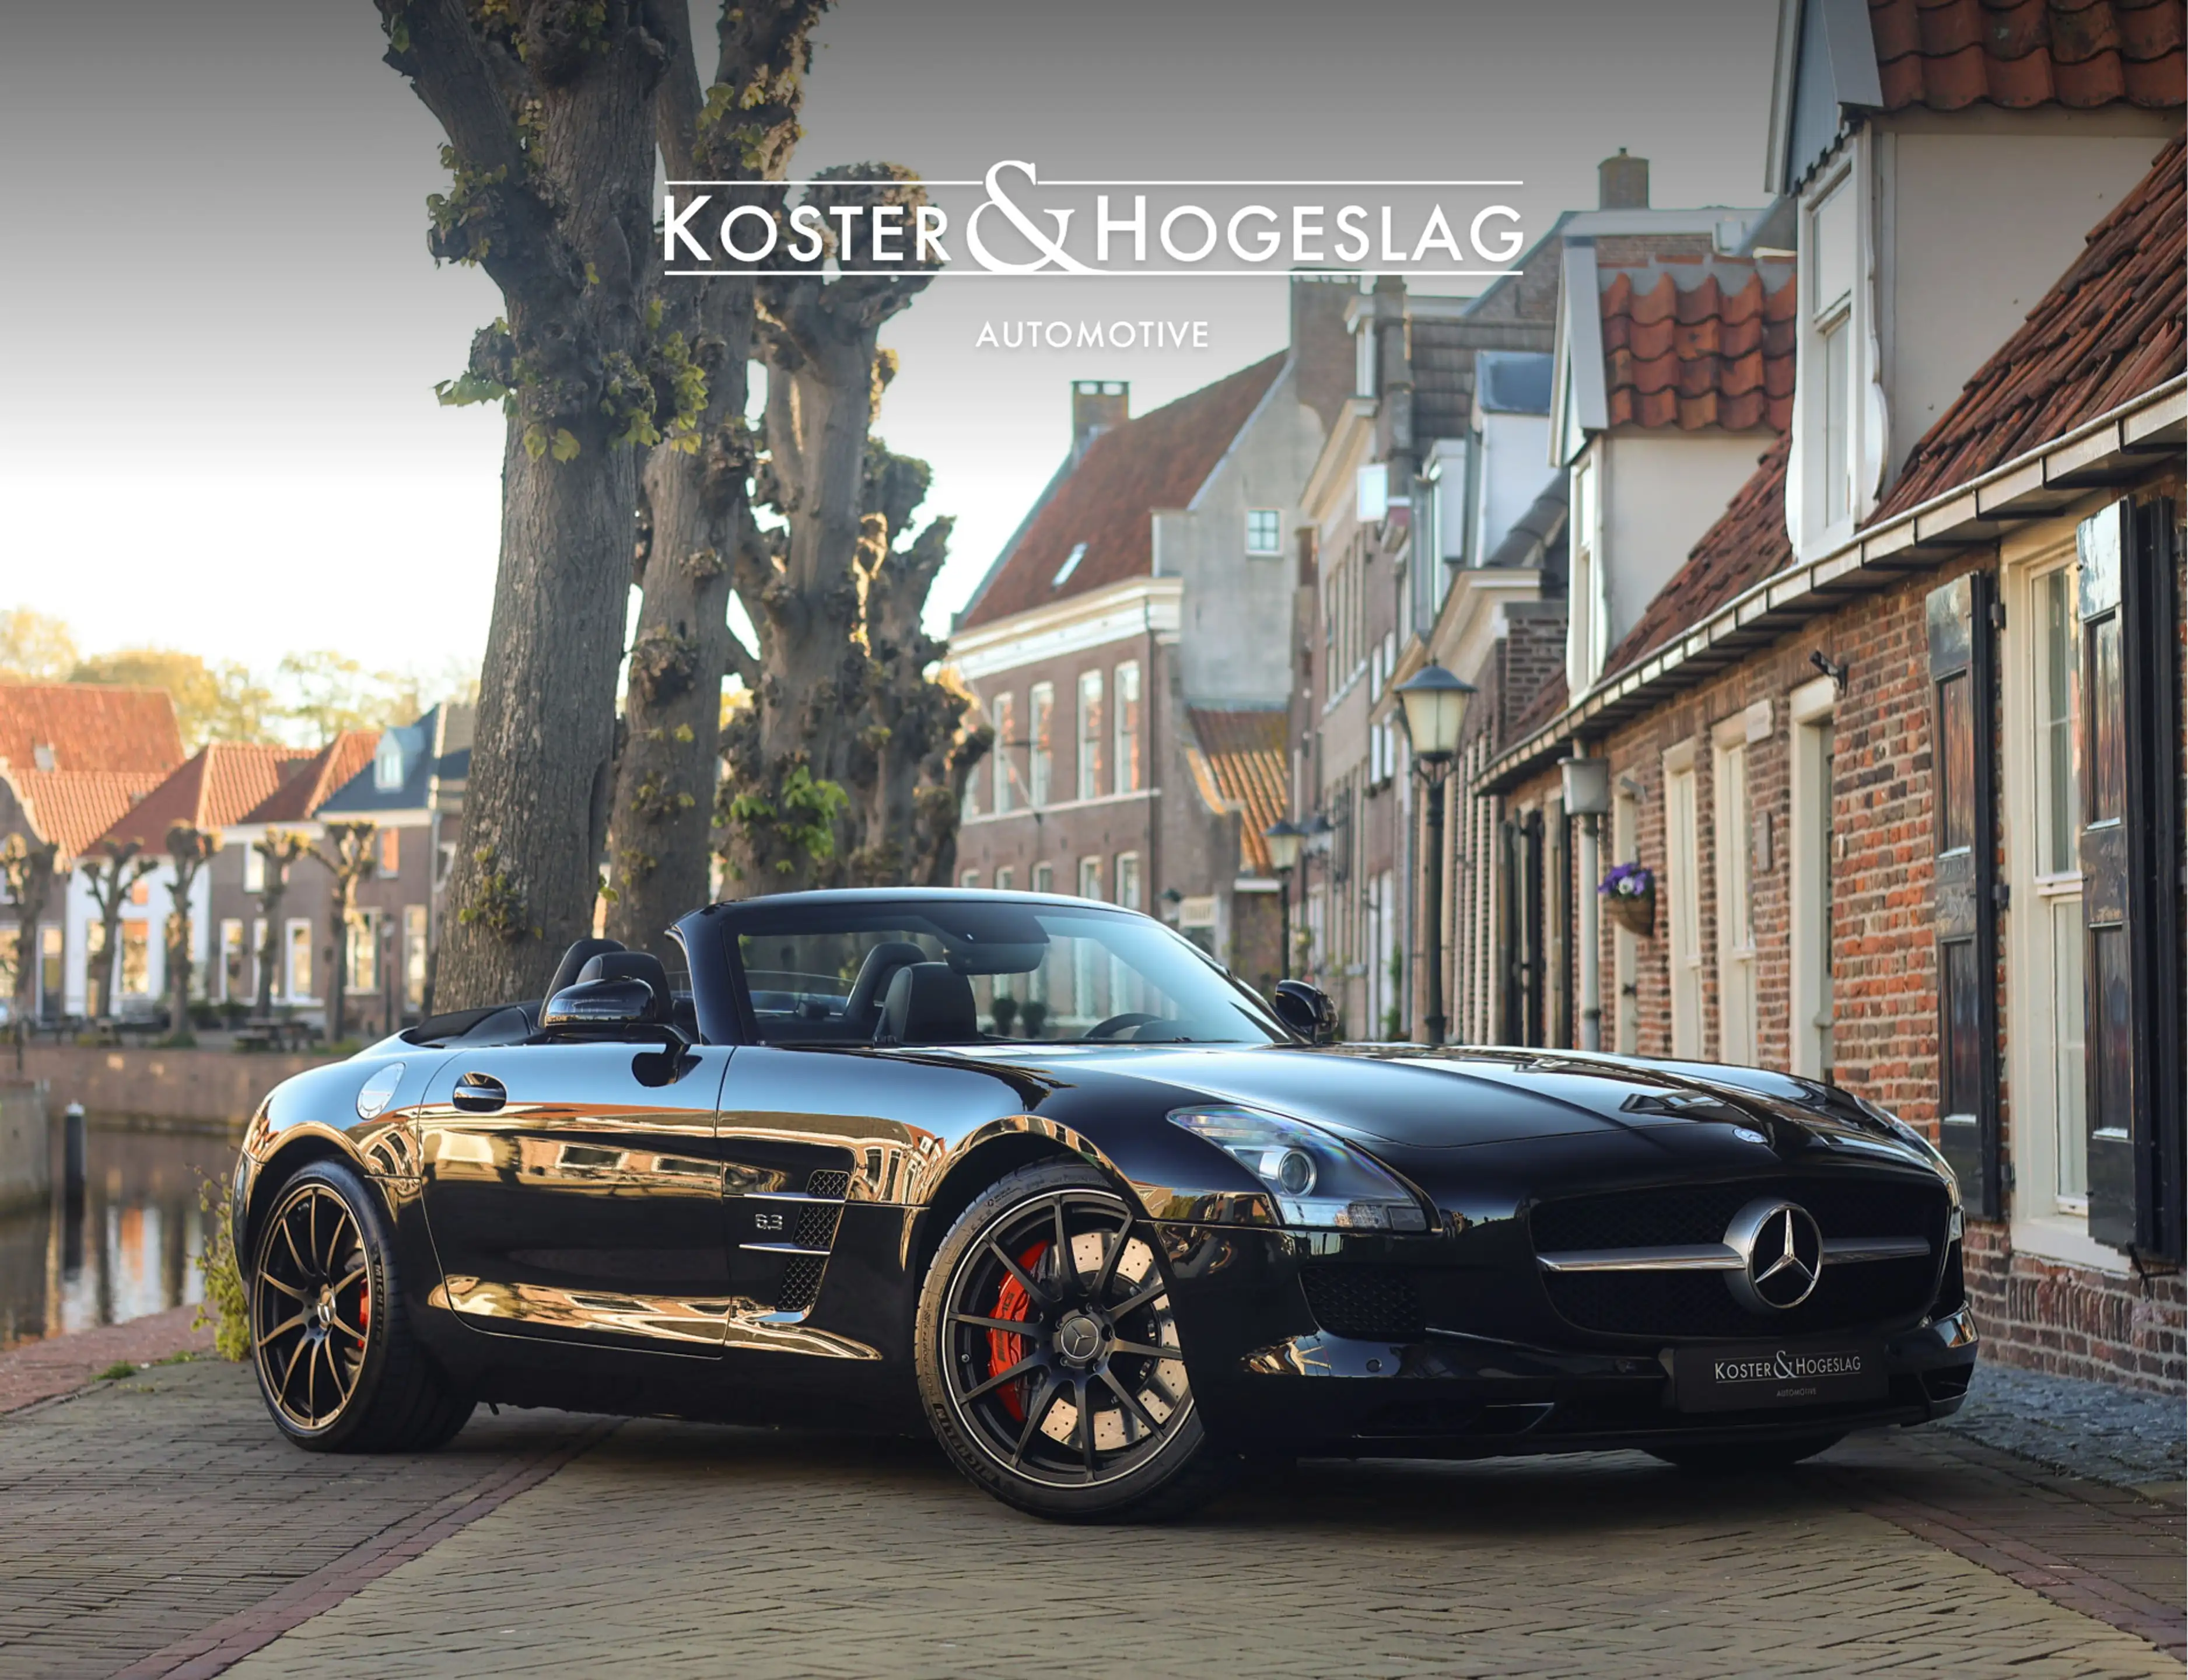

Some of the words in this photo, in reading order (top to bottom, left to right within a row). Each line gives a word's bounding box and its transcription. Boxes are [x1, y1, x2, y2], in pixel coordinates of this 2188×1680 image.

[1715, 1362, 1771, 1379] KOSTER
[1773, 1350, 1794, 1378] &
[1795, 1356, 1861, 1375] HOGESLAG
